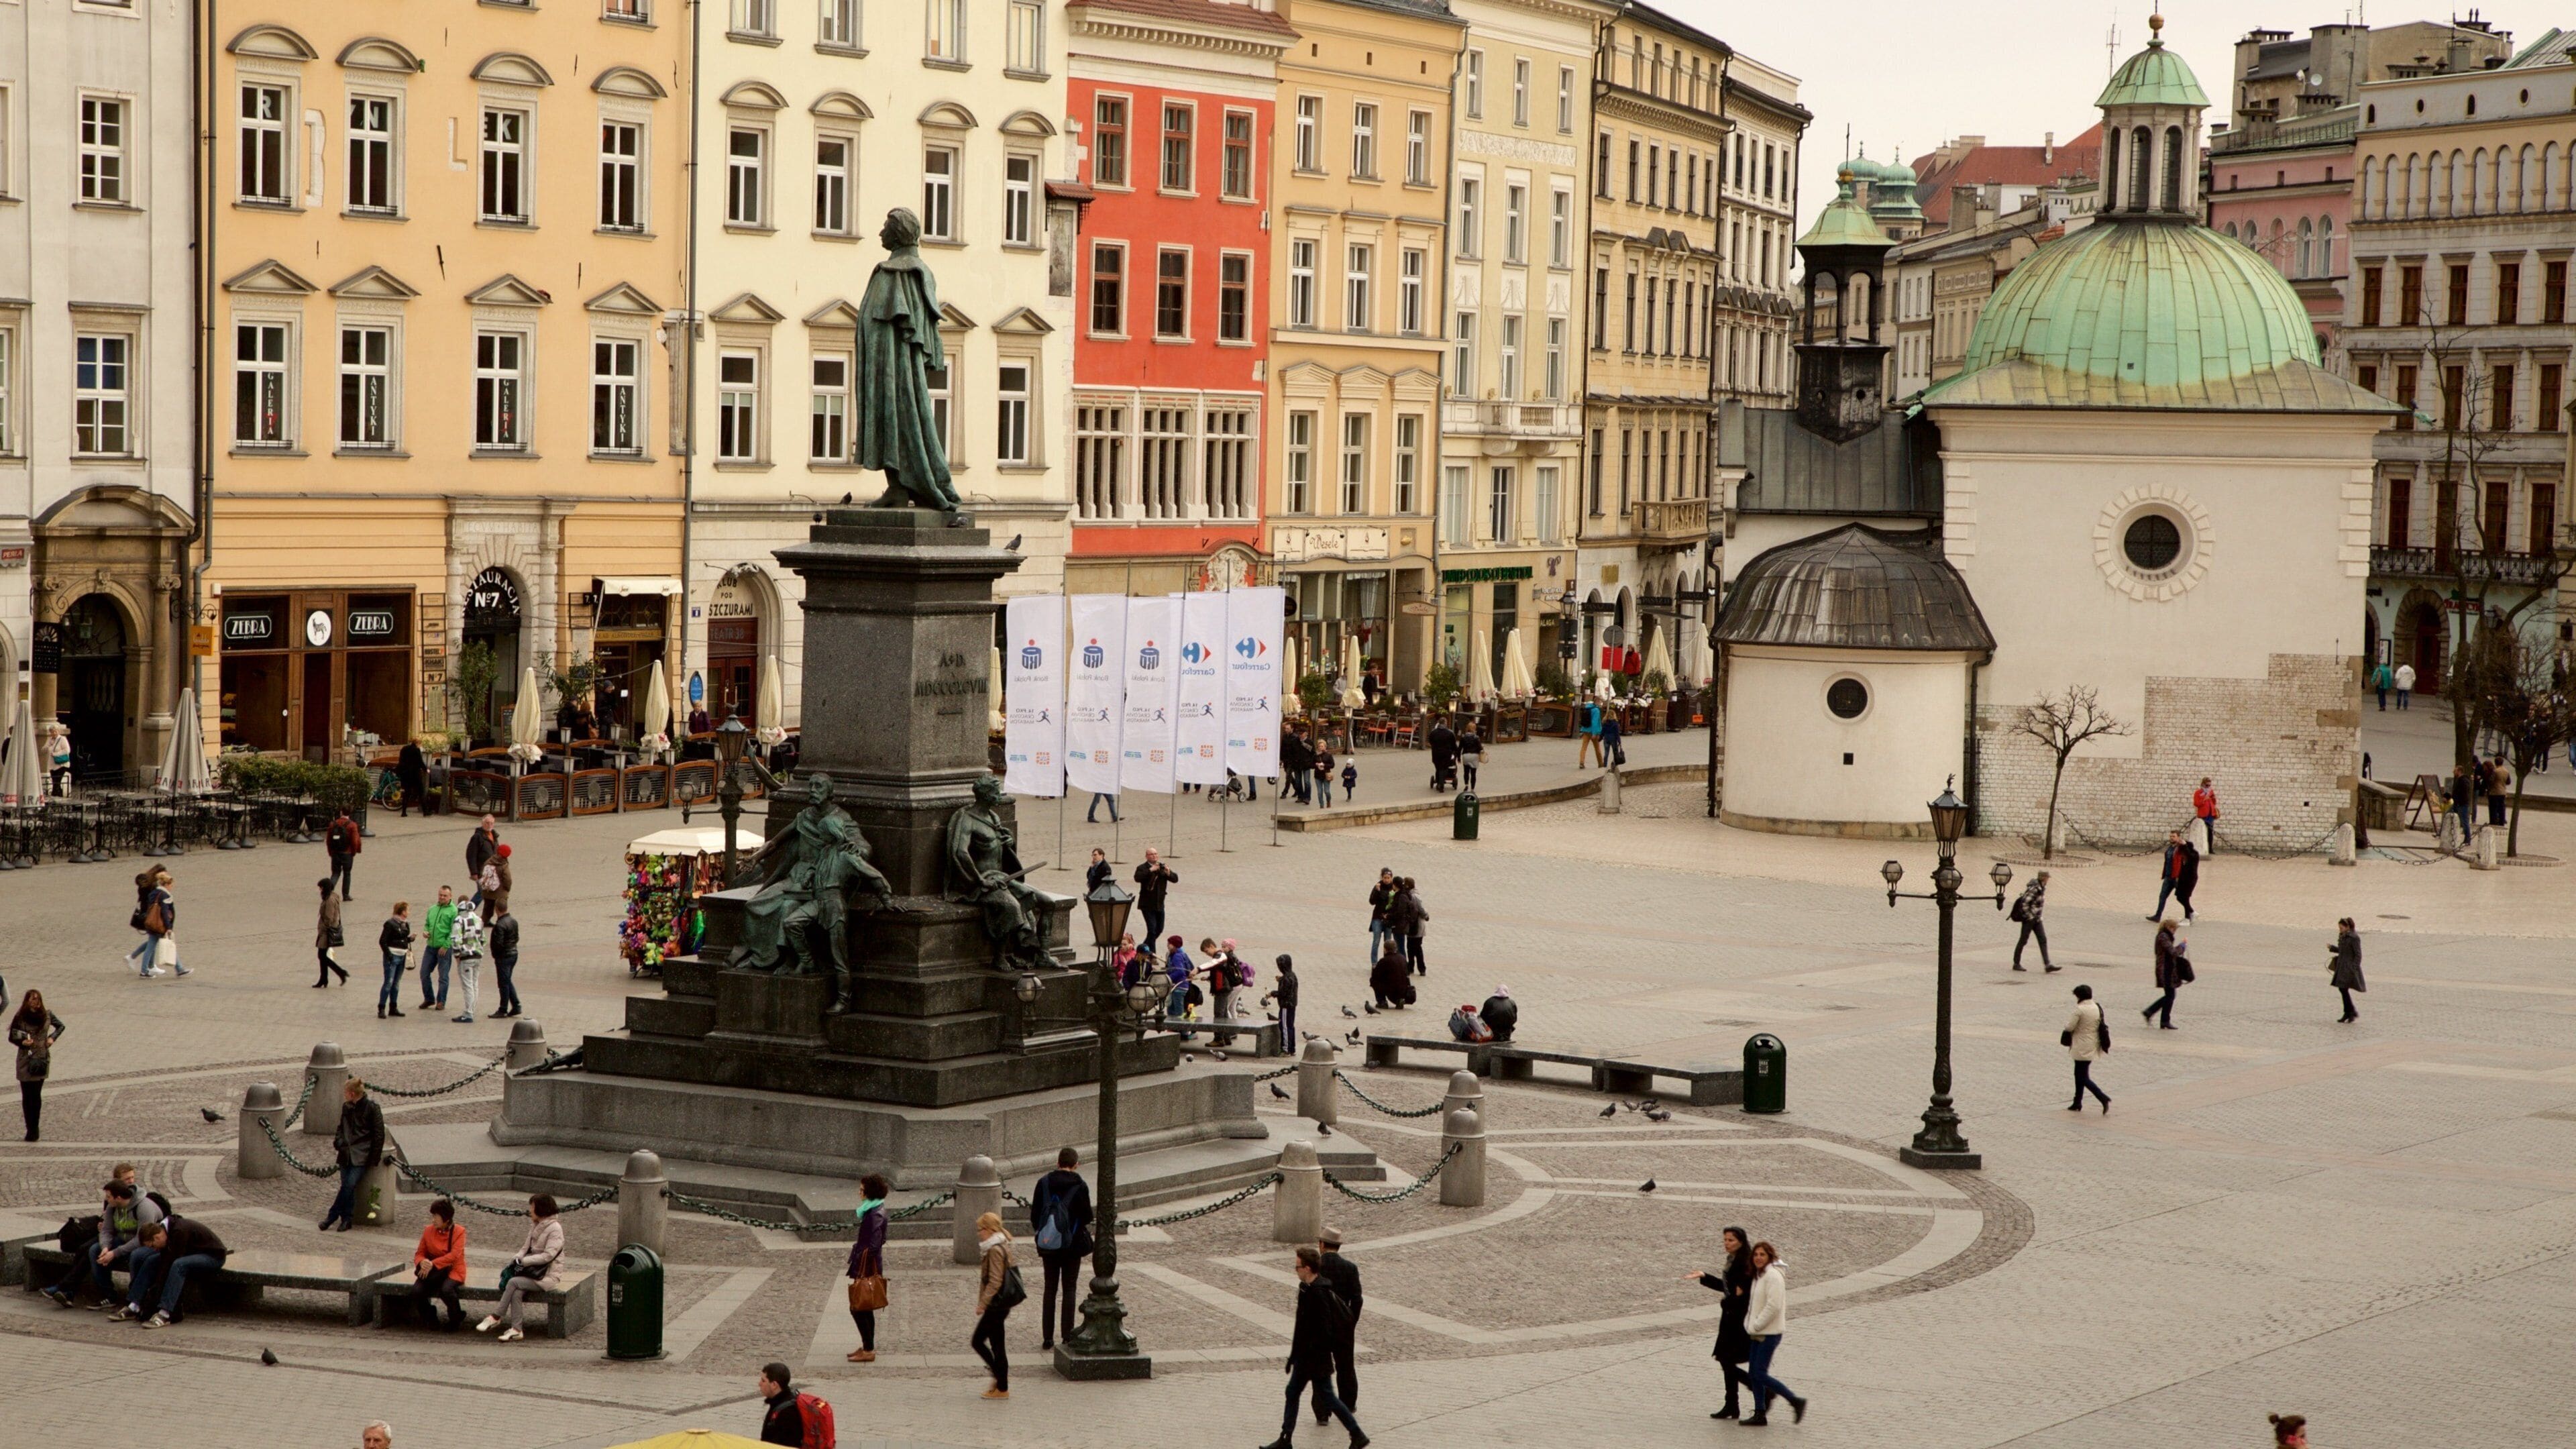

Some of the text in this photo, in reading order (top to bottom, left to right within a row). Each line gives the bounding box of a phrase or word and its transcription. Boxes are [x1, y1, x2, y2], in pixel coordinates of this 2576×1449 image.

[1309, 533, 1339, 550] Wesele
[716, 577, 737, 589] KLUB
[231, 619, 266, 635] ZEBRA
[355, 616, 387, 631] ZEBRA
[710, 628, 734, 639] TEATR
